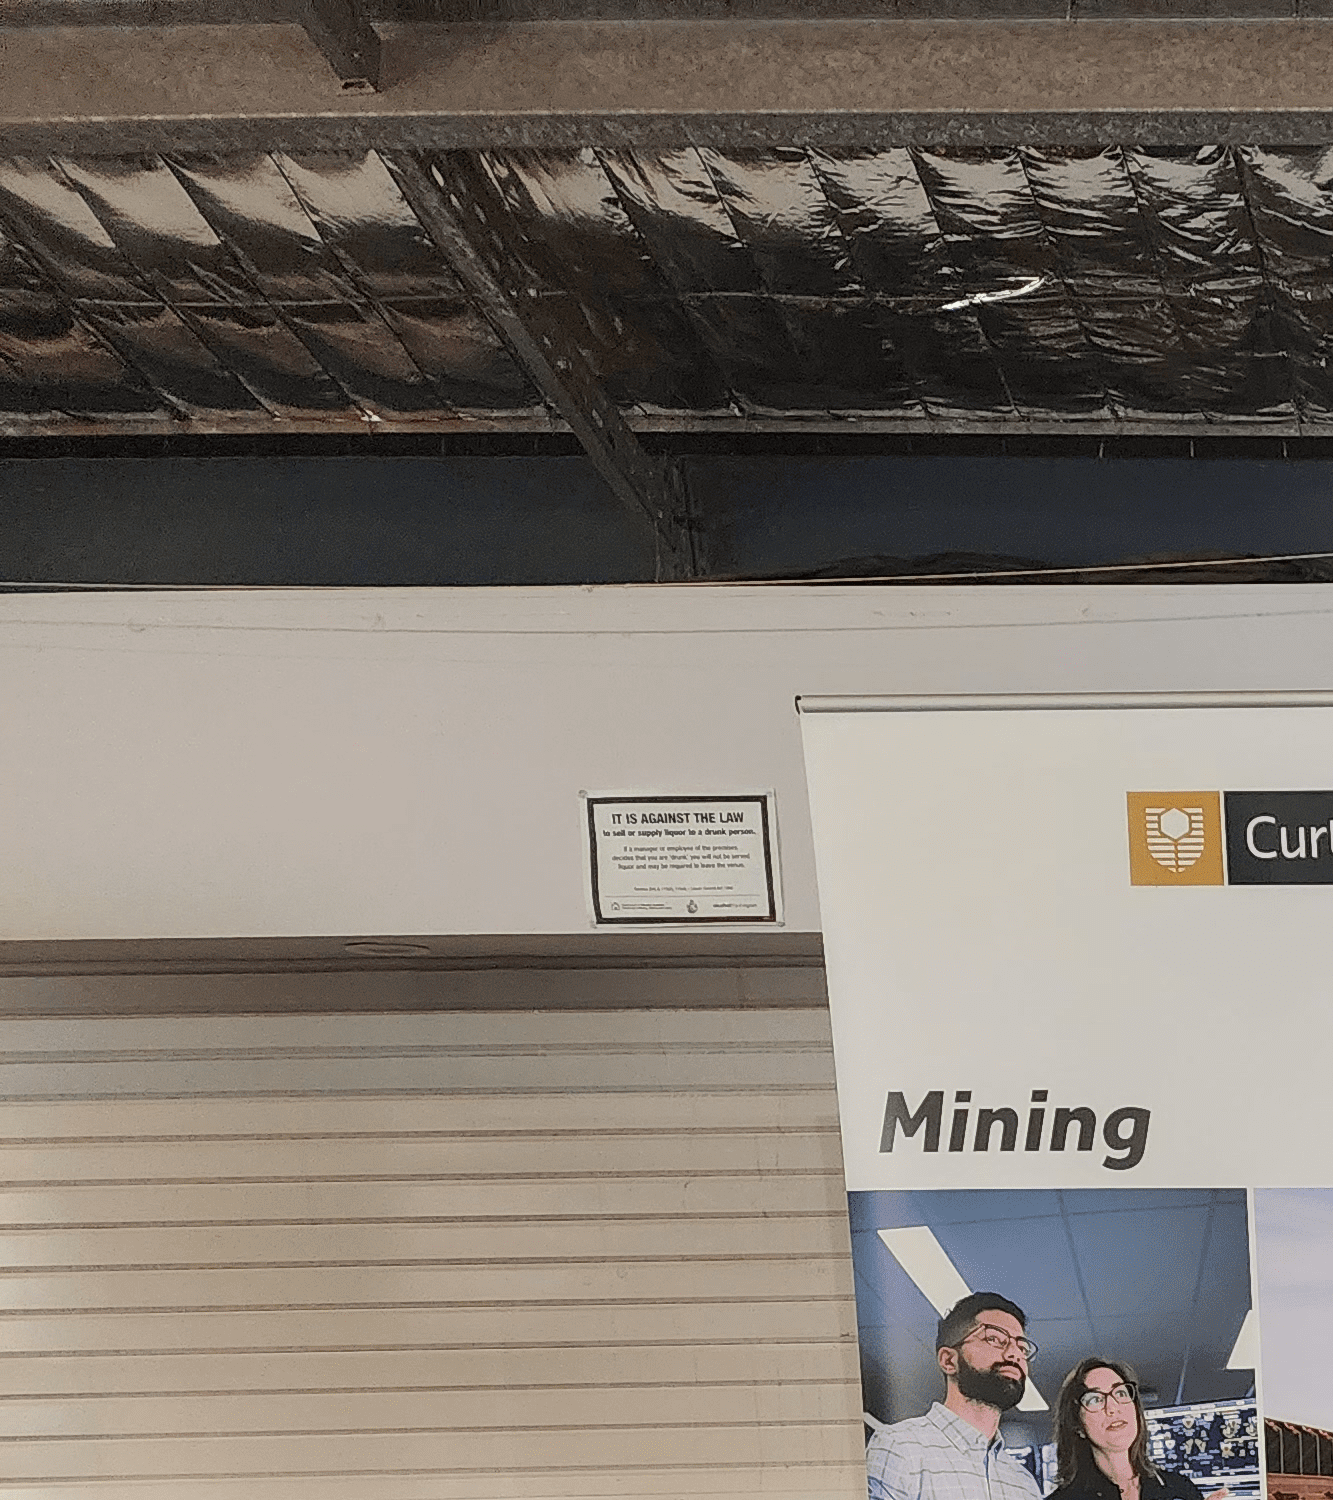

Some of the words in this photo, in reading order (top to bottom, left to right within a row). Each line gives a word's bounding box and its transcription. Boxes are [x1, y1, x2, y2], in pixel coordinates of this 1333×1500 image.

[611, 813, 622, 824] IT
[625, 813, 638, 824] IS
[641, 812, 691, 824] AGAINST
[693, 812, 716, 824] THE
[719, 811, 744, 823] LAW
[602, 829, 611, 837] to
[612, 829, 626, 837] sell
[637, 829, 663, 838] supply
[664, 828, 686, 837] liquor
[688, 828, 696, 836] to
[704, 828, 727, 836] drunk
[878, 1088, 1152, 1171] Mining
